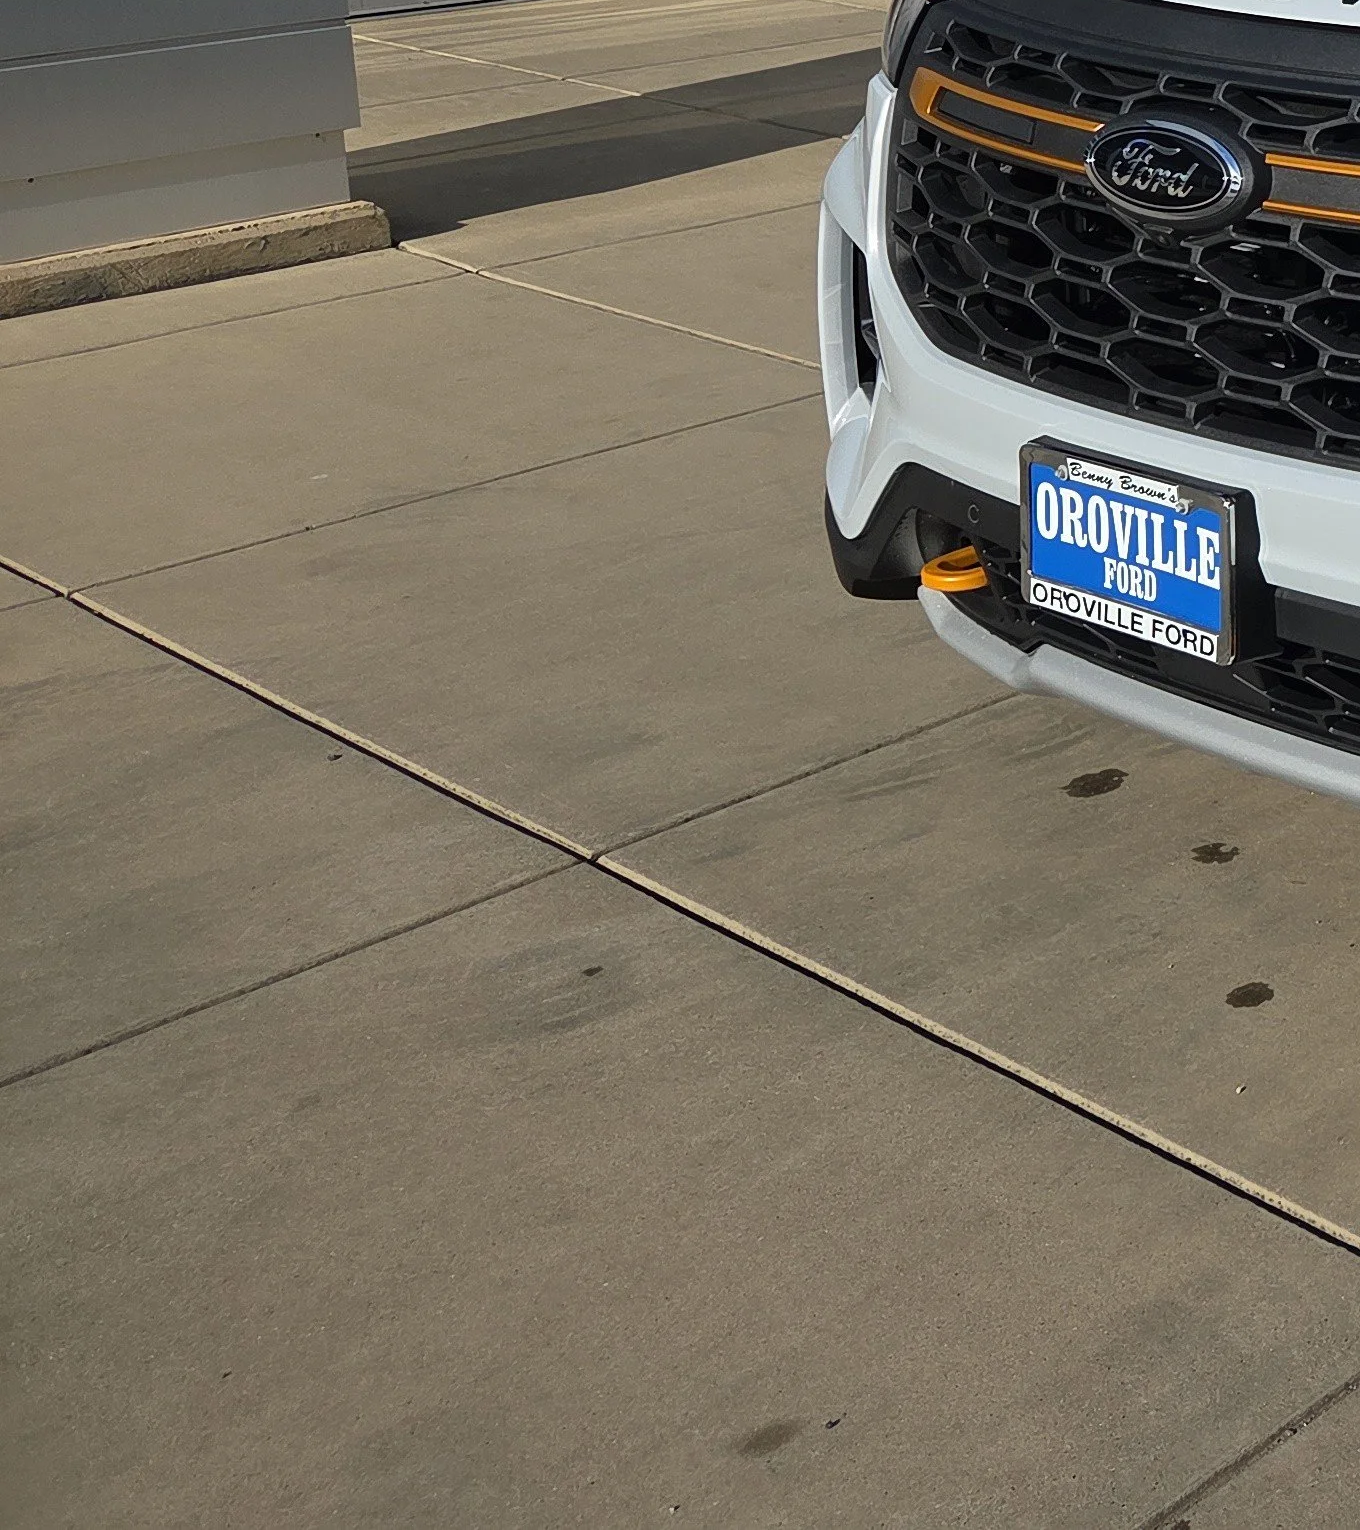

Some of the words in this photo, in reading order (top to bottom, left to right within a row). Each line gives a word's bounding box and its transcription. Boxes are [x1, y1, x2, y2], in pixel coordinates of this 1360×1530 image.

[1111, 138, 1200, 199] Ford
[1069, 461, 1114, 489] Benny
[1118, 475, 1177, 504] Brown's
[1036, 481, 1221, 591] OROVILLE
[1103, 556, 1157, 602] FORD
[1032, 582, 1144, 635] OROVILLE
[1151, 619, 1215, 657] FORD
